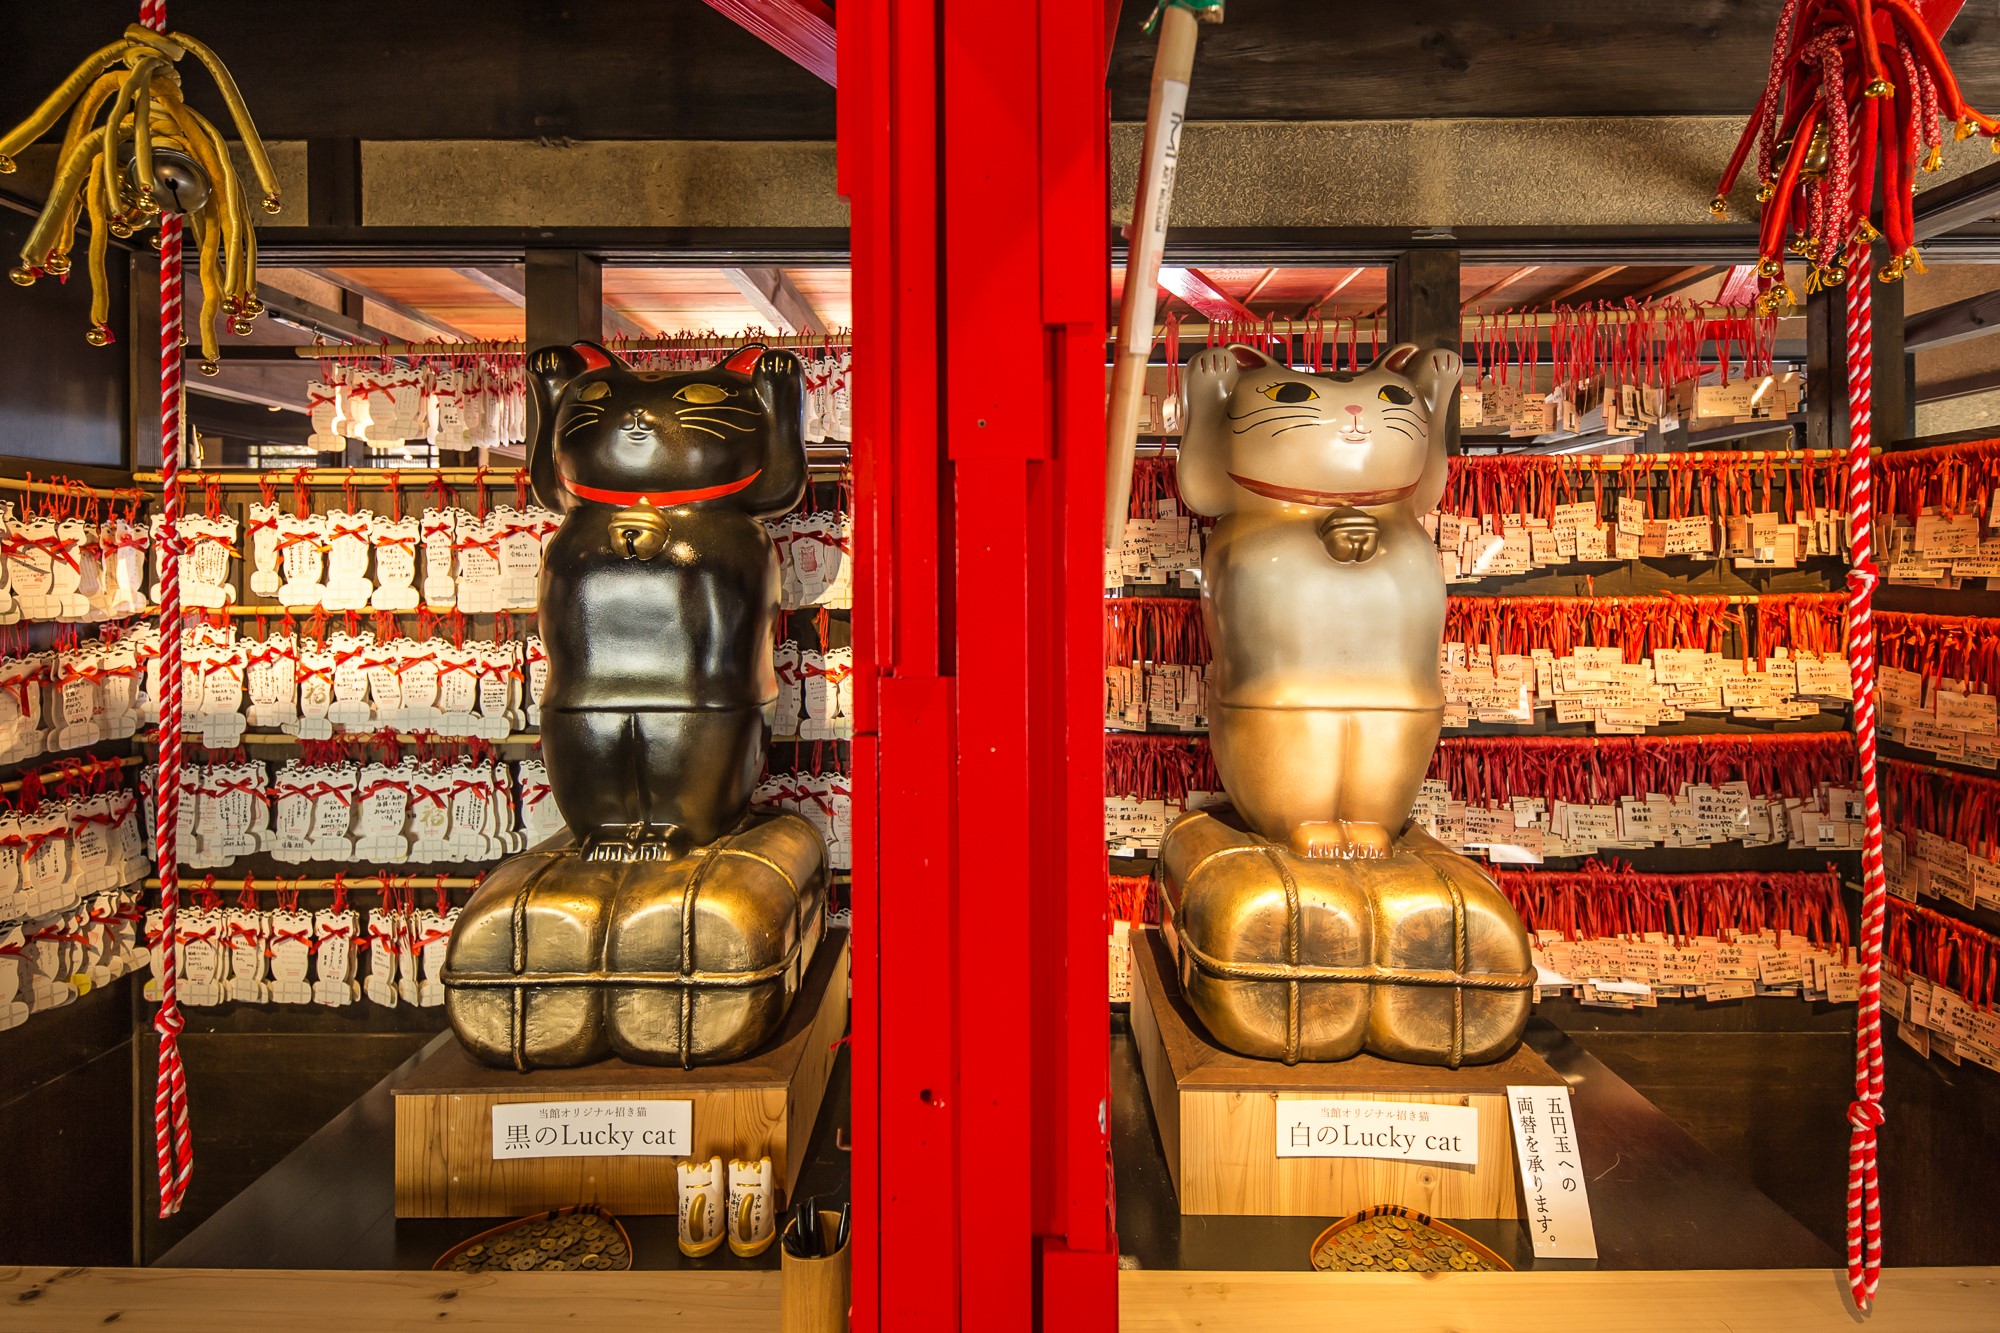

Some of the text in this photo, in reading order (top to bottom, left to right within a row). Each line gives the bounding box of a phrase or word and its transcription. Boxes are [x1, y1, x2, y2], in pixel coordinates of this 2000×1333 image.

[420, 804, 445, 827] 福
[539, 1106, 647, 1119] 当館オリジナル招き猫
[1320, 1106, 1430, 1122] 当館オリジナル招き猫
[505, 1122, 676, 1151] 黒のLucky cat
[1290, 1121, 1462, 1155] 白のLucky cat
[1546, 1097, 1577, 1192] 五円玉への
[1516, 1096, 1556, 1242] 両替を承ります。
